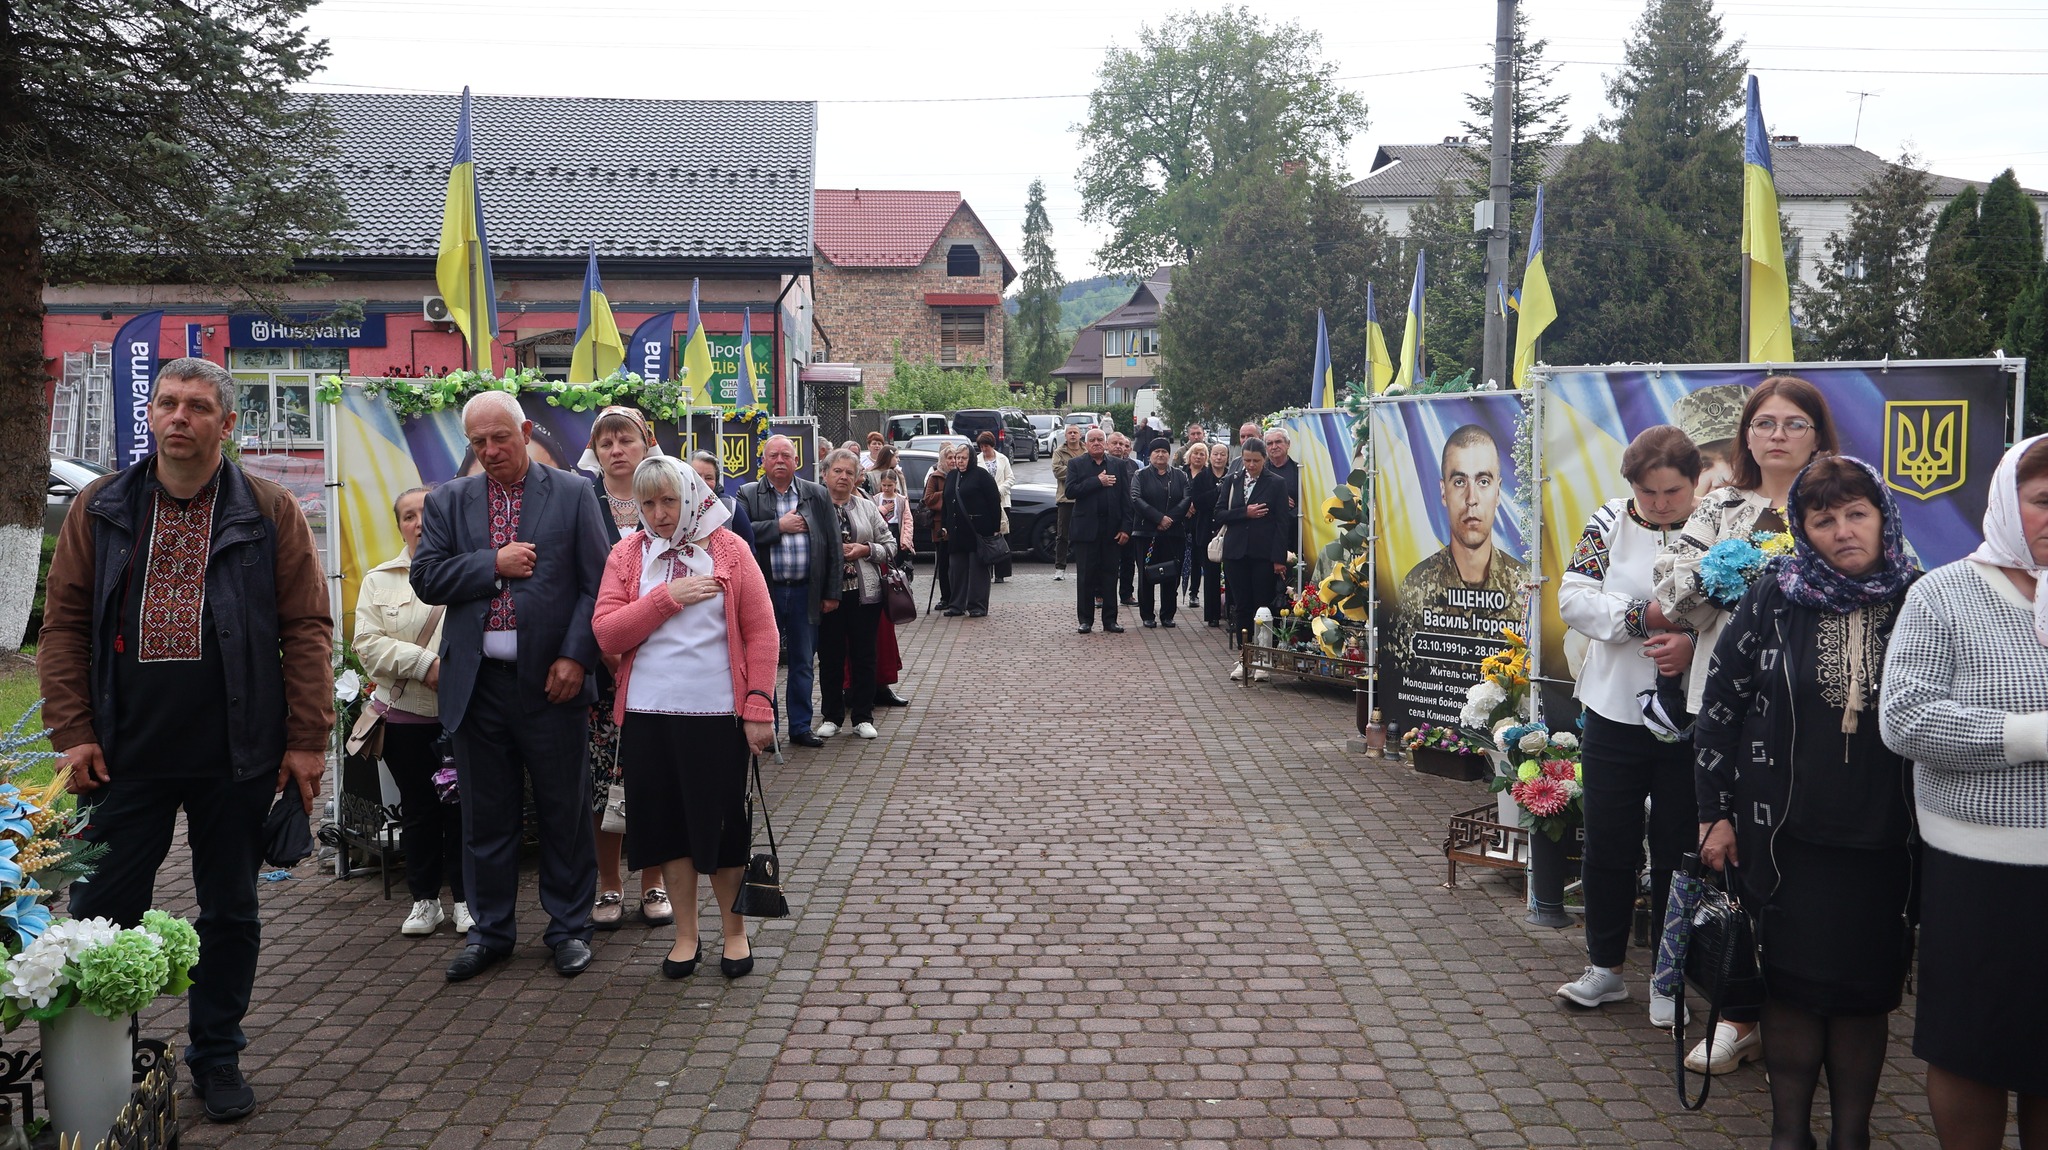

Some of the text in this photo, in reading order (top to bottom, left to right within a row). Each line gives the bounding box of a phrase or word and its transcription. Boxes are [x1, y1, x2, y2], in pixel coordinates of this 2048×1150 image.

[271, 323, 360, 341] Husqvarna
[129, 341, 149, 466] Husqvarna
[1448, 589, 1505, 610] ІЩЕНКО
[1423, 609, 1524, 635] Василь Ігорови
[1430, 666, 1460, 679] Житель
[1461, 672, 1478, 681] смт.
[1402, 676, 1469, 696] Молодший сержа
[1398, 692, 1468, 709] виконання бойово
[1408, 708, 1460, 724] села Клинове
